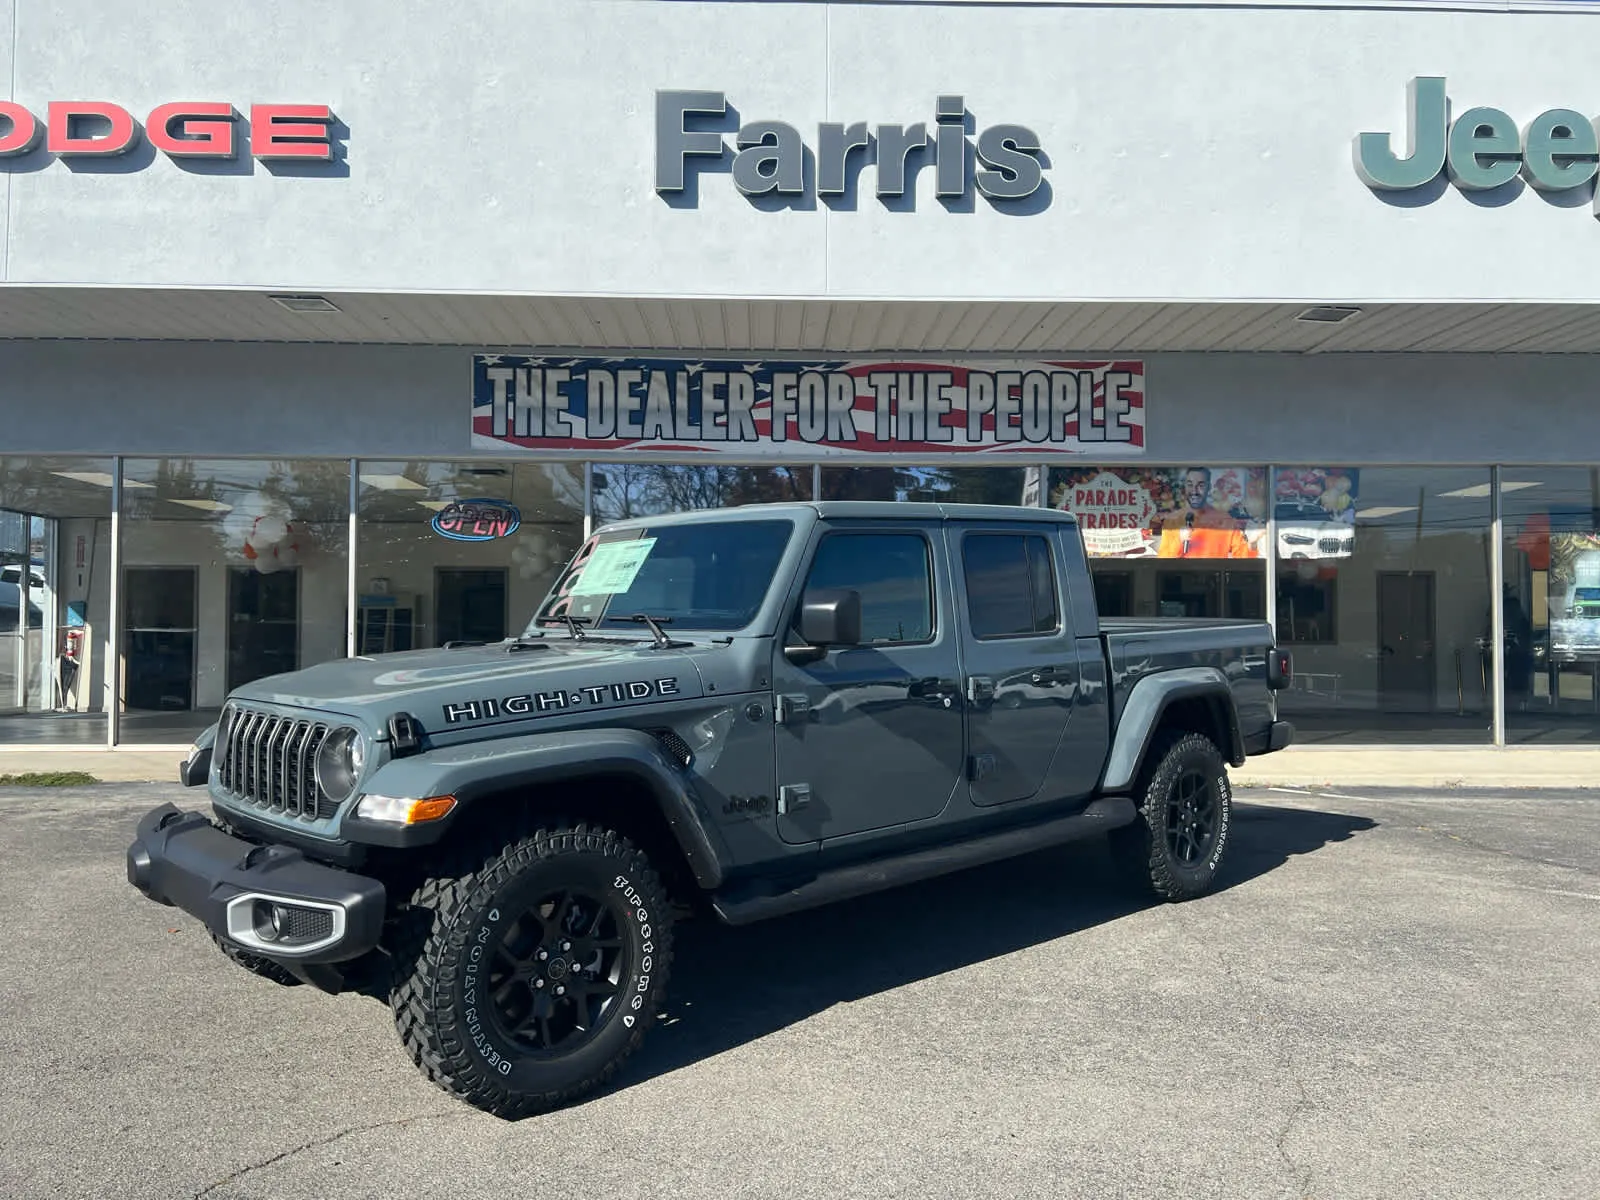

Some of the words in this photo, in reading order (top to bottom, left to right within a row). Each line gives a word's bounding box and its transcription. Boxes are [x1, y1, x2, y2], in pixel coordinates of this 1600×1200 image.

[655, 90, 1043, 199] Farris
[1352, 76, 1600, 222] Jee
[486, 367, 573, 438] THE
[585, 368, 759, 442] DEALER
[770, 370, 857, 443] FOR
[868, 371, 954, 442] THE
[966, 371, 1132, 443] PEOPLE
[440, 503, 512, 537] OPEN
[1075, 489, 1138, 506] PARADE
[1075, 512, 1138, 529] TRADES
[614, 875, 654, 1010] Firestone
[464, 926, 512, 1075] DESTINATION
